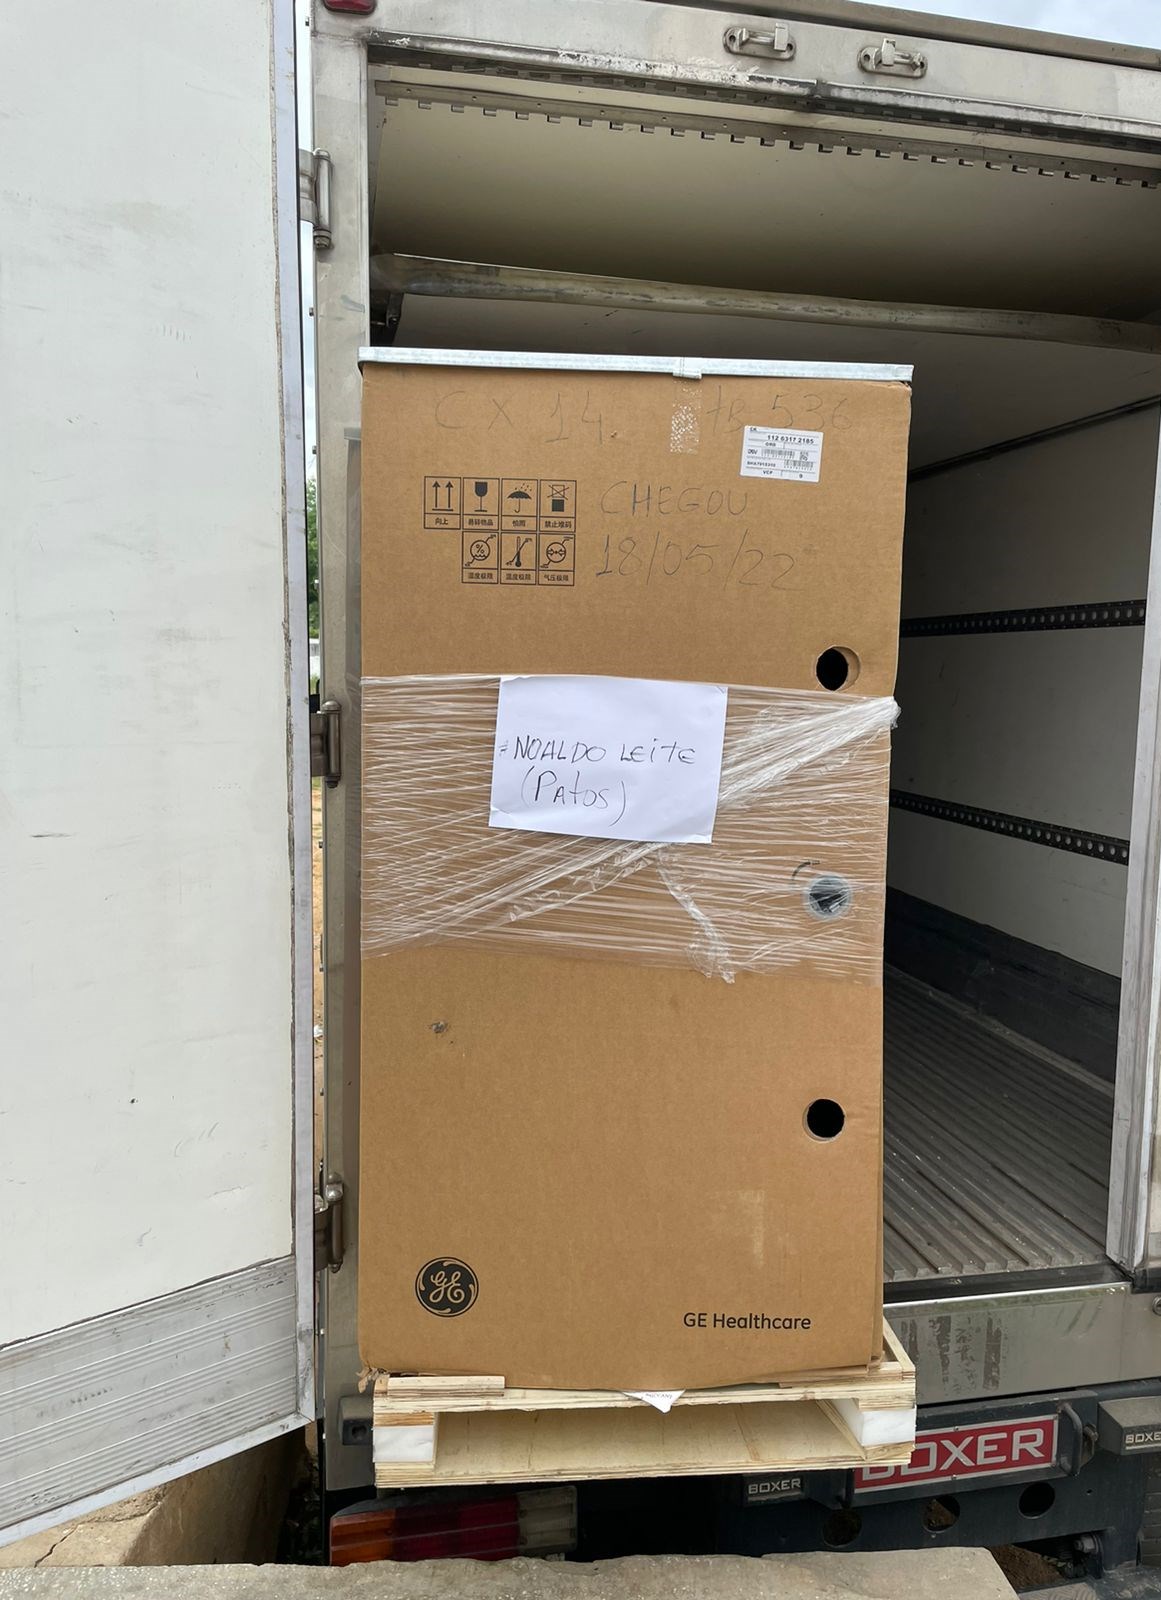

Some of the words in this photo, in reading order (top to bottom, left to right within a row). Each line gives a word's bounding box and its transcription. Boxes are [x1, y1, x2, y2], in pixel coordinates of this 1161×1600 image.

[601, 481, 748, 517] CHEGOU
[596, 528, 804, 591] 18/05/22
[514, 735, 606, 763] NOALDO
[683, 1312, 707, 1328] GE
[713, 1312, 811, 1330] Healthcare
[748, 1478, 801, 1495] BOXER
